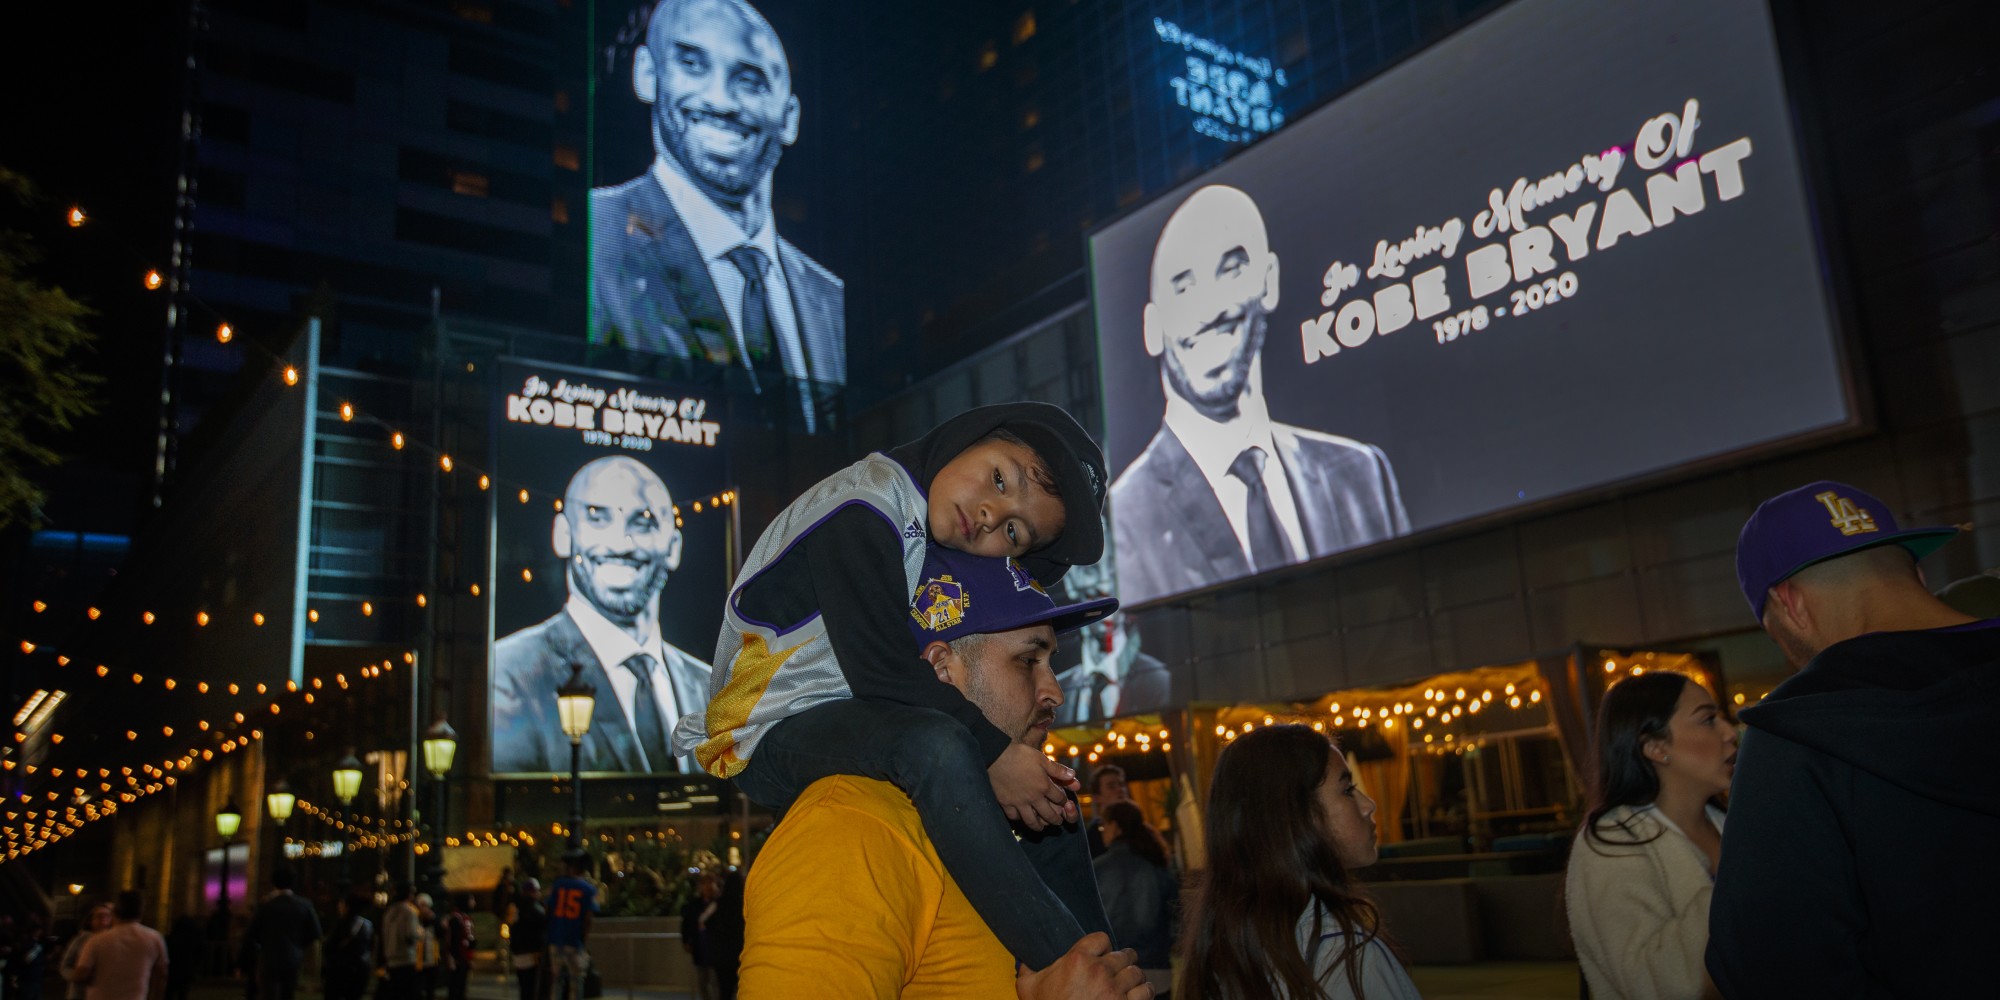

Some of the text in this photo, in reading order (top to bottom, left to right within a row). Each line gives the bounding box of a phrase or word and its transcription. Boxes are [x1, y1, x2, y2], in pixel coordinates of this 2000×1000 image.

[1321, 98, 1701, 307] In Loving Memory Of
[1300, 137, 1752, 364] KOBE BRYANT
[1432, 305, 1489, 344] 1978
[1510, 271, 1579, 317] 2020
[507, 394, 720, 446] KOBE BRYANT
[523, 375, 706, 421] In Loving Memory Of
[1814, 490, 1879, 536] LA
[936, 608, 951, 623] 24
[553, 886, 583, 920] 15
